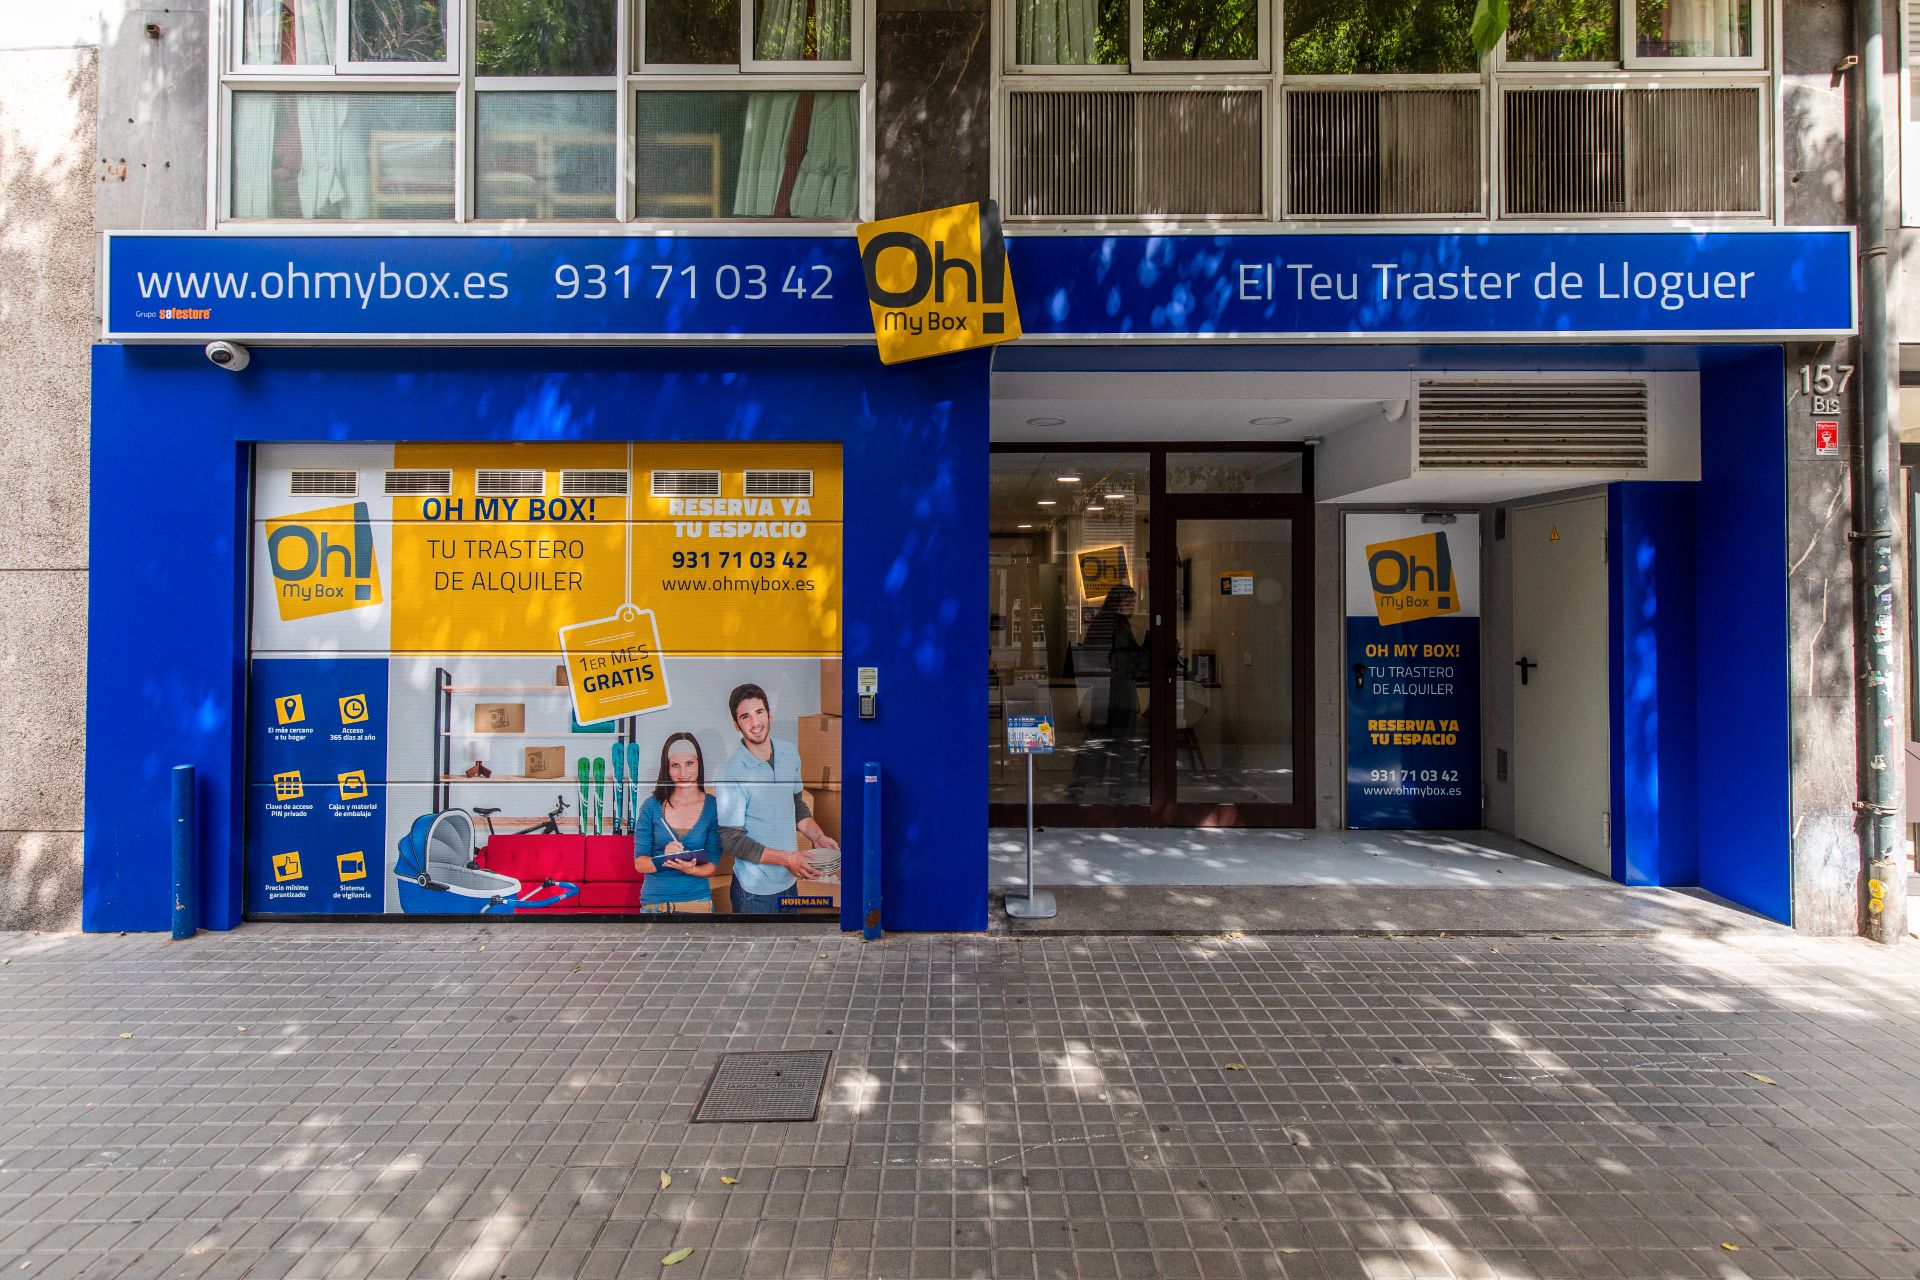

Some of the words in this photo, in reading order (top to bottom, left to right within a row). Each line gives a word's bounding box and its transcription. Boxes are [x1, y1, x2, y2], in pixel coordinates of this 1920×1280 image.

[862, 199, 1006, 335] Oh!
[138, 261, 509, 309] www.ohmybox.es
[554, 264, 630, 300] 931
[650, 264, 698, 300] 71
[716, 264, 767, 300] 03
[781, 264, 834, 300] 42
[1239, 262, 1273, 300] El
[1287, 263, 1358, 300] Teu
[1372, 263, 1520, 300] Traster
[1534, 261, 1583, 300] de
[1599, 261, 1755, 311] Lloguer
[135, 310, 157, 319] Grupo
[159, 307, 210, 320] safestore
[884, 311, 923, 336] My
[929, 312, 968, 332] Box
[1800, 363, 1855, 395] 157
[422, 497, 463, 521] OH
[474, 497, 519, 521] MY
[529, 497, 596, 521] BOX!
[669, 498, 775, 517] RESERVA
[779, 498, 812, 517] YA
[674, 521, 703, 539] TU
[708, 521, 807, 539] ESPACIO
[267, 501, 374, 601] Oh!
[427, 540, 456, 560] TU
[463, 540, 585, 560] TRASTERO
[672, 551, 711, 569] 931
[720, 551, 742, 569] 71
[750, 551, 776, 569] 03
[782, 551, 808, 569] 42
[1368, 531, 1452, 610] Oh!
[282, 584, 312, 601] My
[316, 584, 344, 598] Box
[435, 571, 464, 591] DE
[472, 571, 583, 594] ALQUILER
[662, 575, 815, 595] www.ohmybox.es
[1380, 596, 1404, 610] My
[1406, 596, 1430, 608] Box
[611, 644, 649, 667] MES
[1365, 644, 1389, 658] OH
[1394, 644, 1418, 658] MY
[1424, 644, 1460, 658] BOX!
[583, 664, 655, 693] GRATIS
[1368, 666, 1385, 678] TU
[1388, 666, 1454, 678] TRASTERO
[1373, 684, 1390, 695] DE
[1392, 684, 1454, 696] ALQUILER
[1368, 720, 1436, 732] RESERVA
[1438, 720, 1460, 732] YA
[1370, 734, 1390, 746] TU
[1394, 734, 1457, 746] ESPACIO
[1370, 770, 1396, 782] 931
[1401, 770, 1416, 782] 71
[1420, 770, 1438, 782] 03
[1442, 770, 1458, 782] 42
[1364, 785, 1462, 798] www.ohmybox.es
